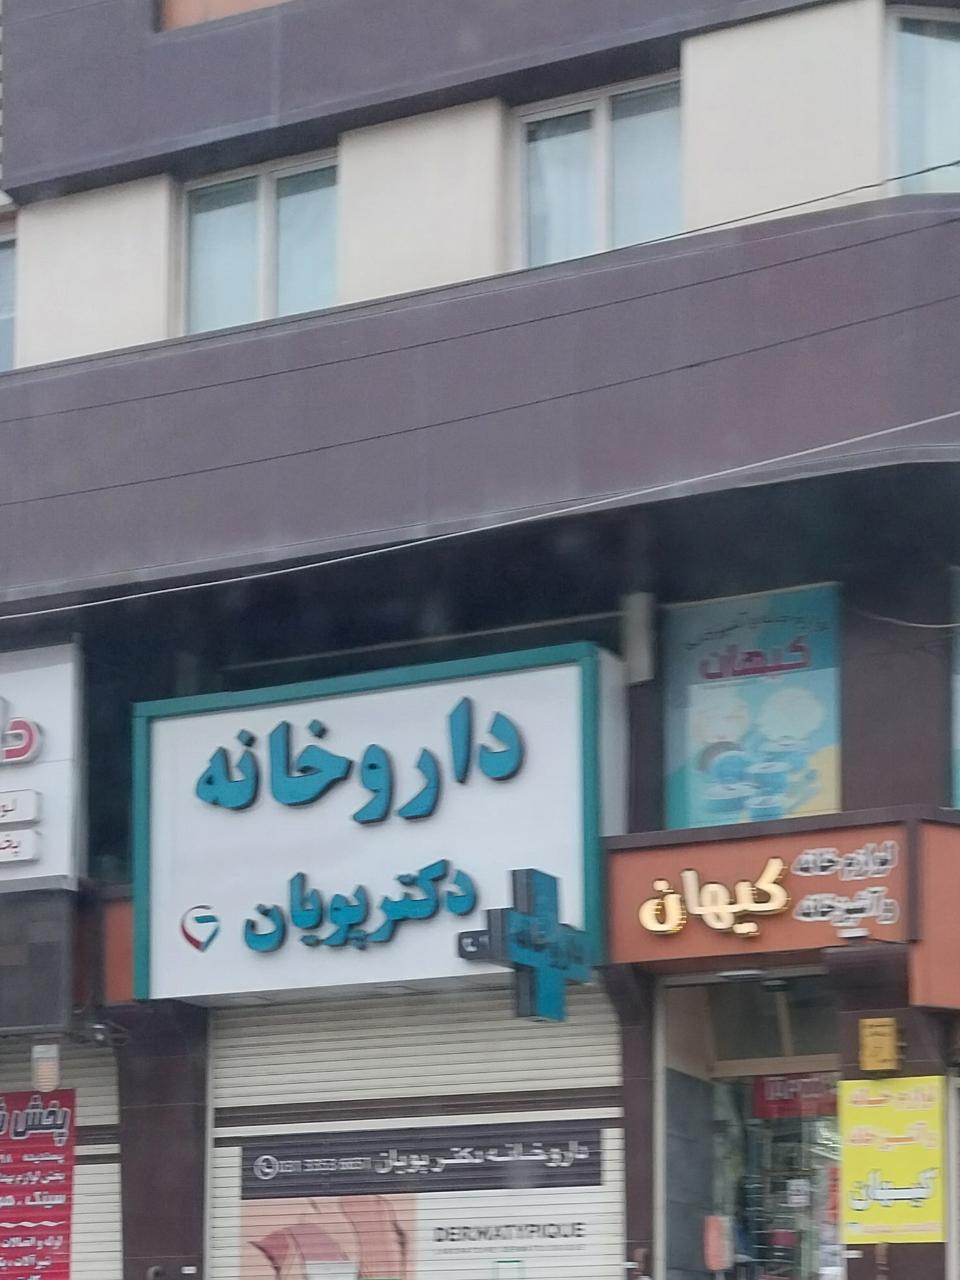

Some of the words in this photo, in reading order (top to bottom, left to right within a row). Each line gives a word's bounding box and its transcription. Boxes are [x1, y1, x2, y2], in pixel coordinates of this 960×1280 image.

[700, 634, 811, 681] کیهان
[196, 697, 524, 824] داروخانه
[244, 871, 370, 952] پویان
[368, 859, 477, 943] دکتر
[639, 857, 790, 935] کیهان
[10, 1094, 71, 1147] پخش
